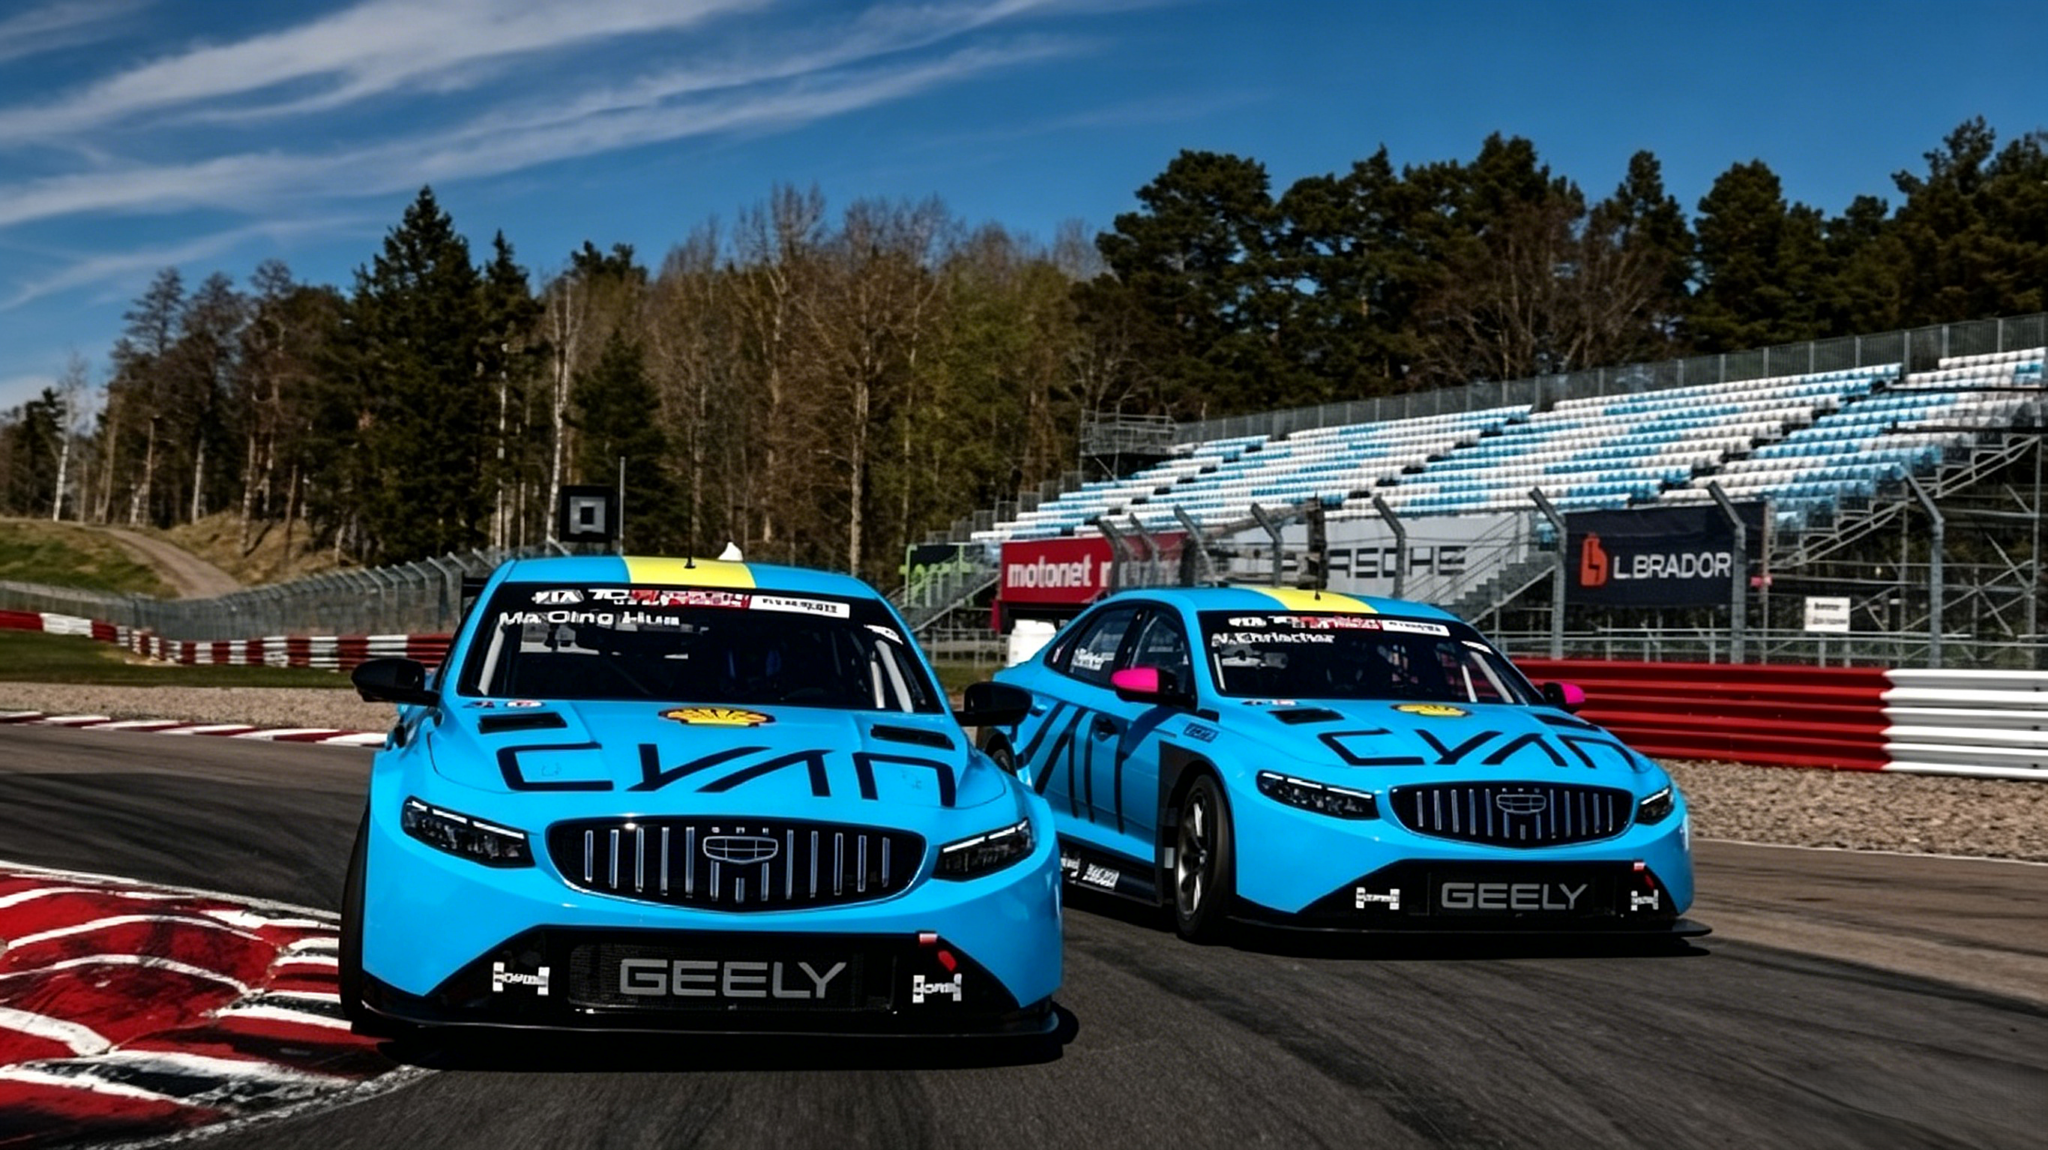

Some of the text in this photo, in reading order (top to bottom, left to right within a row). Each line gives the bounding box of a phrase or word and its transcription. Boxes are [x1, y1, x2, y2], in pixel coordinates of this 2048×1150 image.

[1007, 554, 1093, 589] motonet
[497, 742, 957, 807] CYAN
[1441, 882, 1588, 910] GEELY
[620, 958, 847, 999] GEELY
